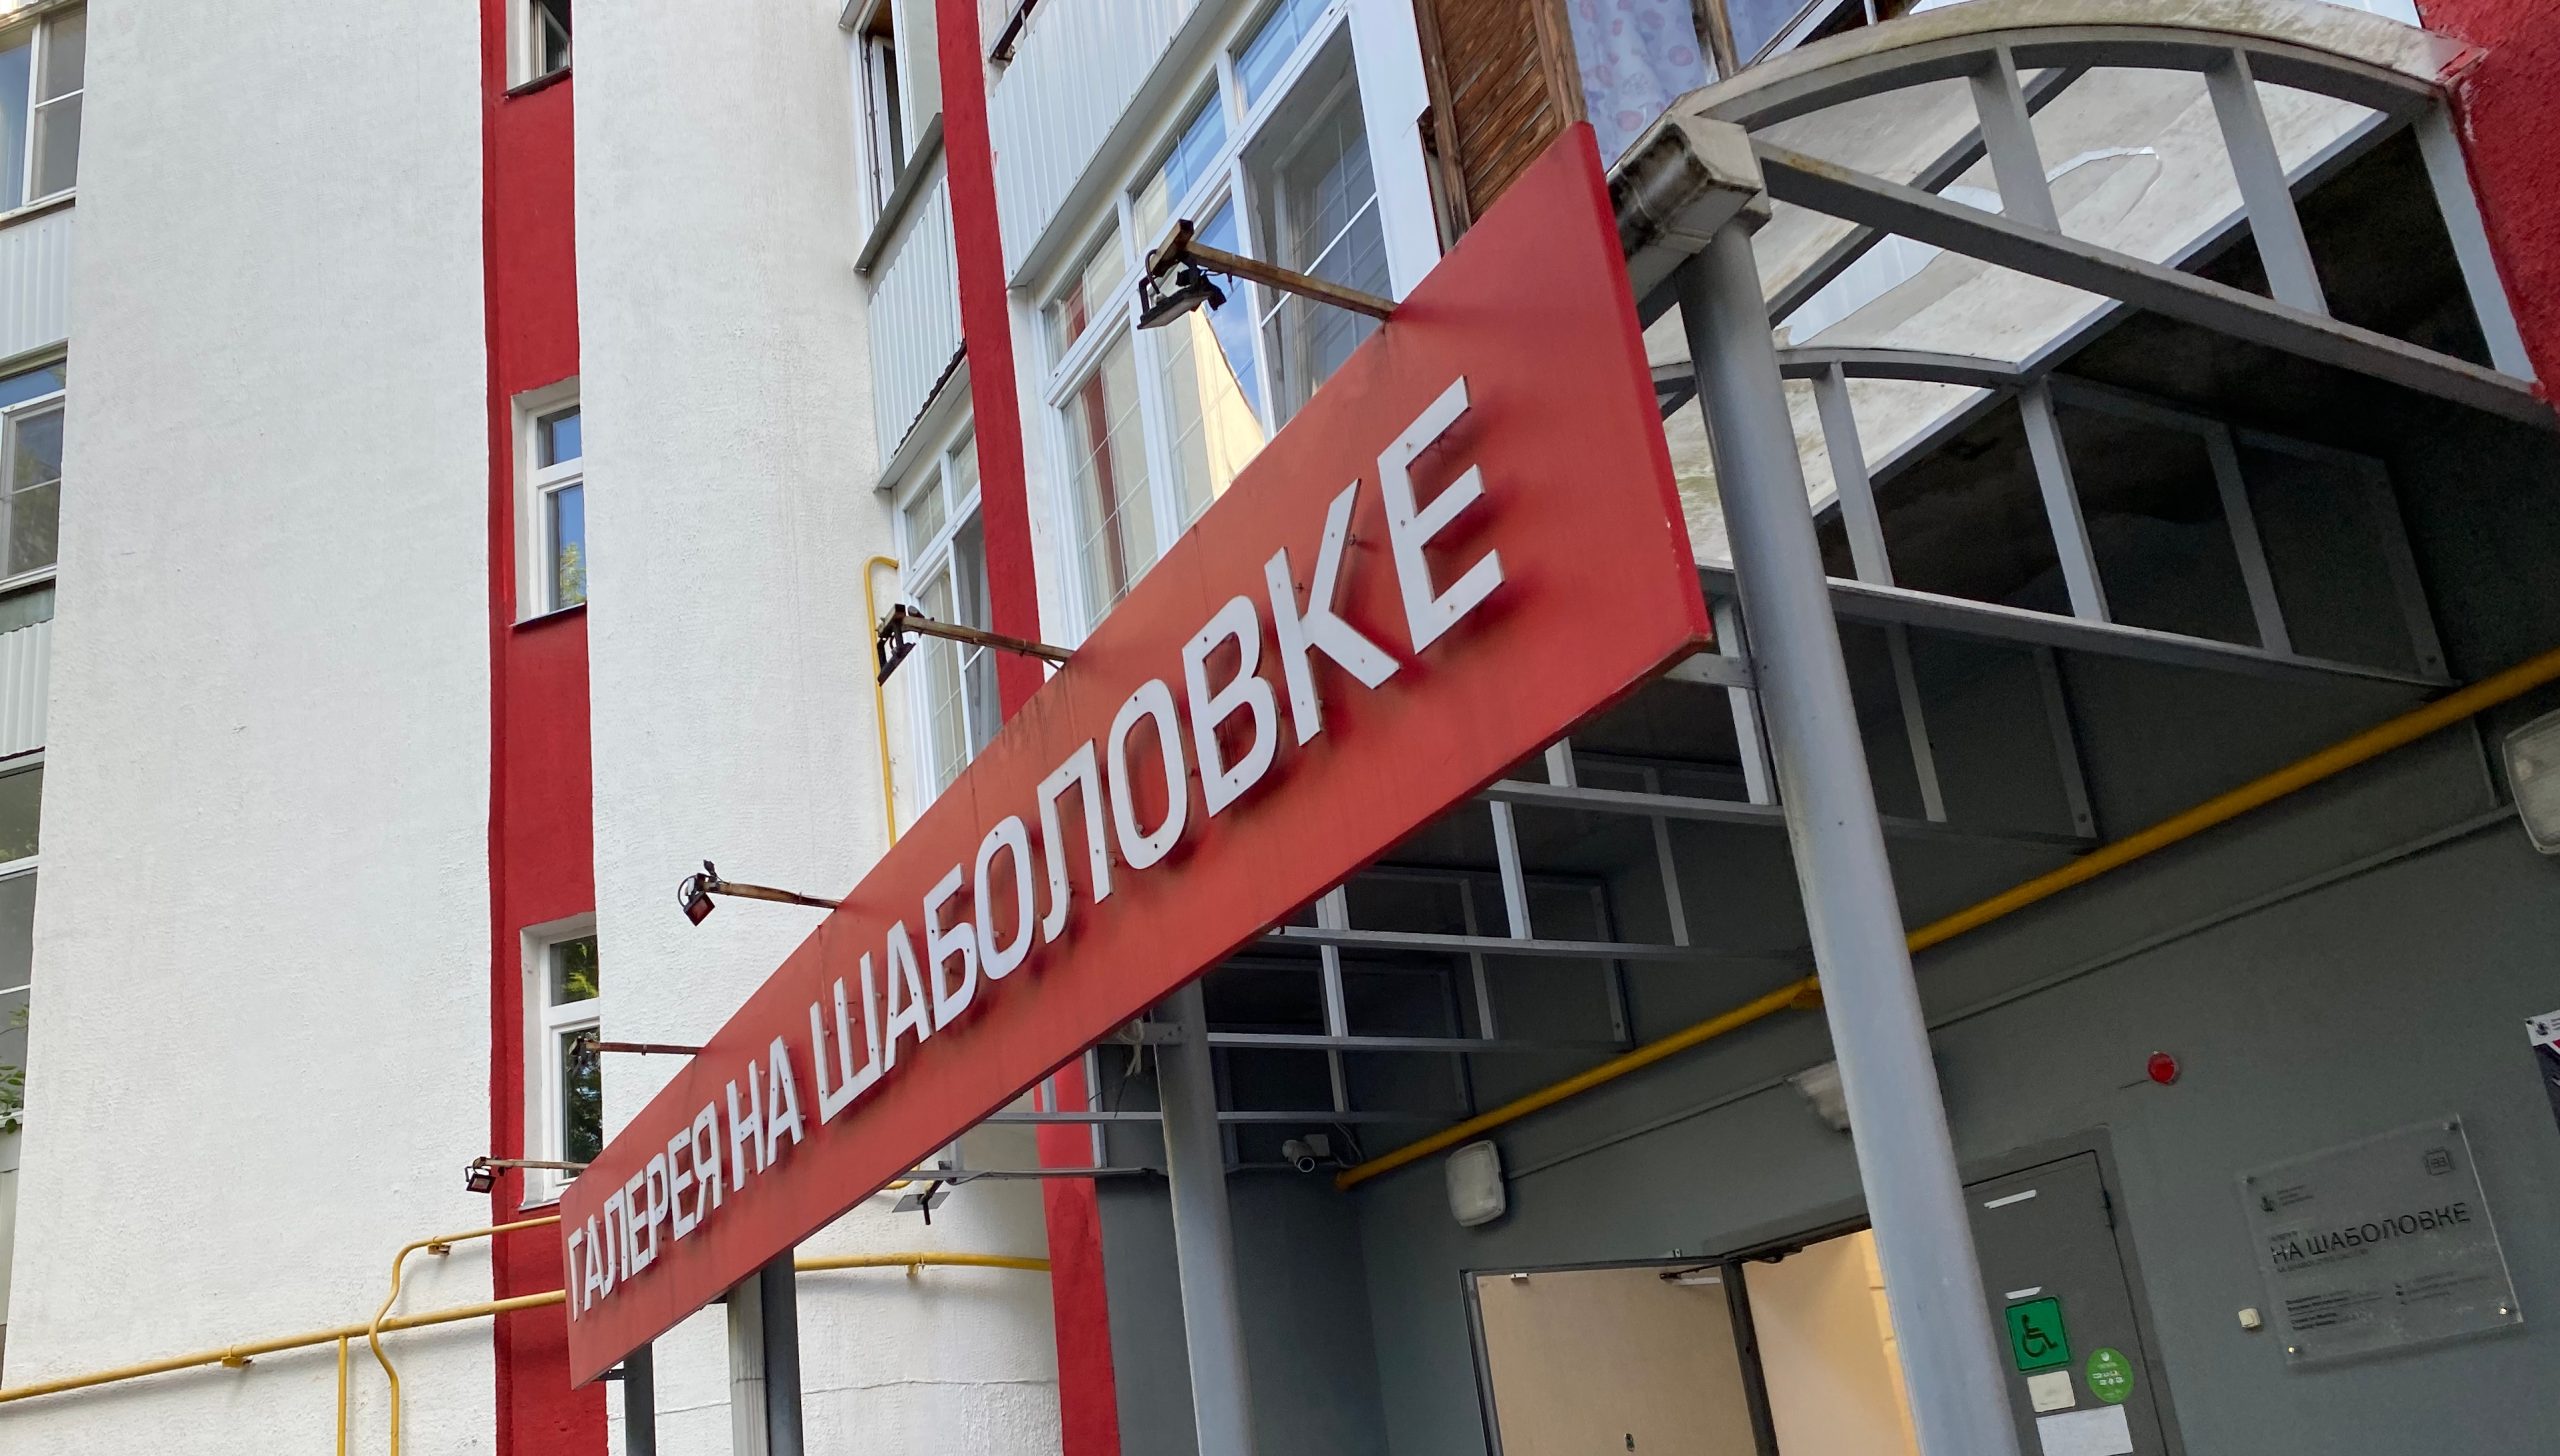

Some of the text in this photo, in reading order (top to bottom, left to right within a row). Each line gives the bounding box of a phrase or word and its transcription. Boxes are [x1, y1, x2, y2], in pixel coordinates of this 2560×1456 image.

[567, 374, 1505, 1322] ГАЛЕРЕЯ НА ШАБОЛОВКЕ
[2270, 1241, 2304, 1265] НА
[2305, 1202, 2471, 1256] ШАБОЛОВКЕ
